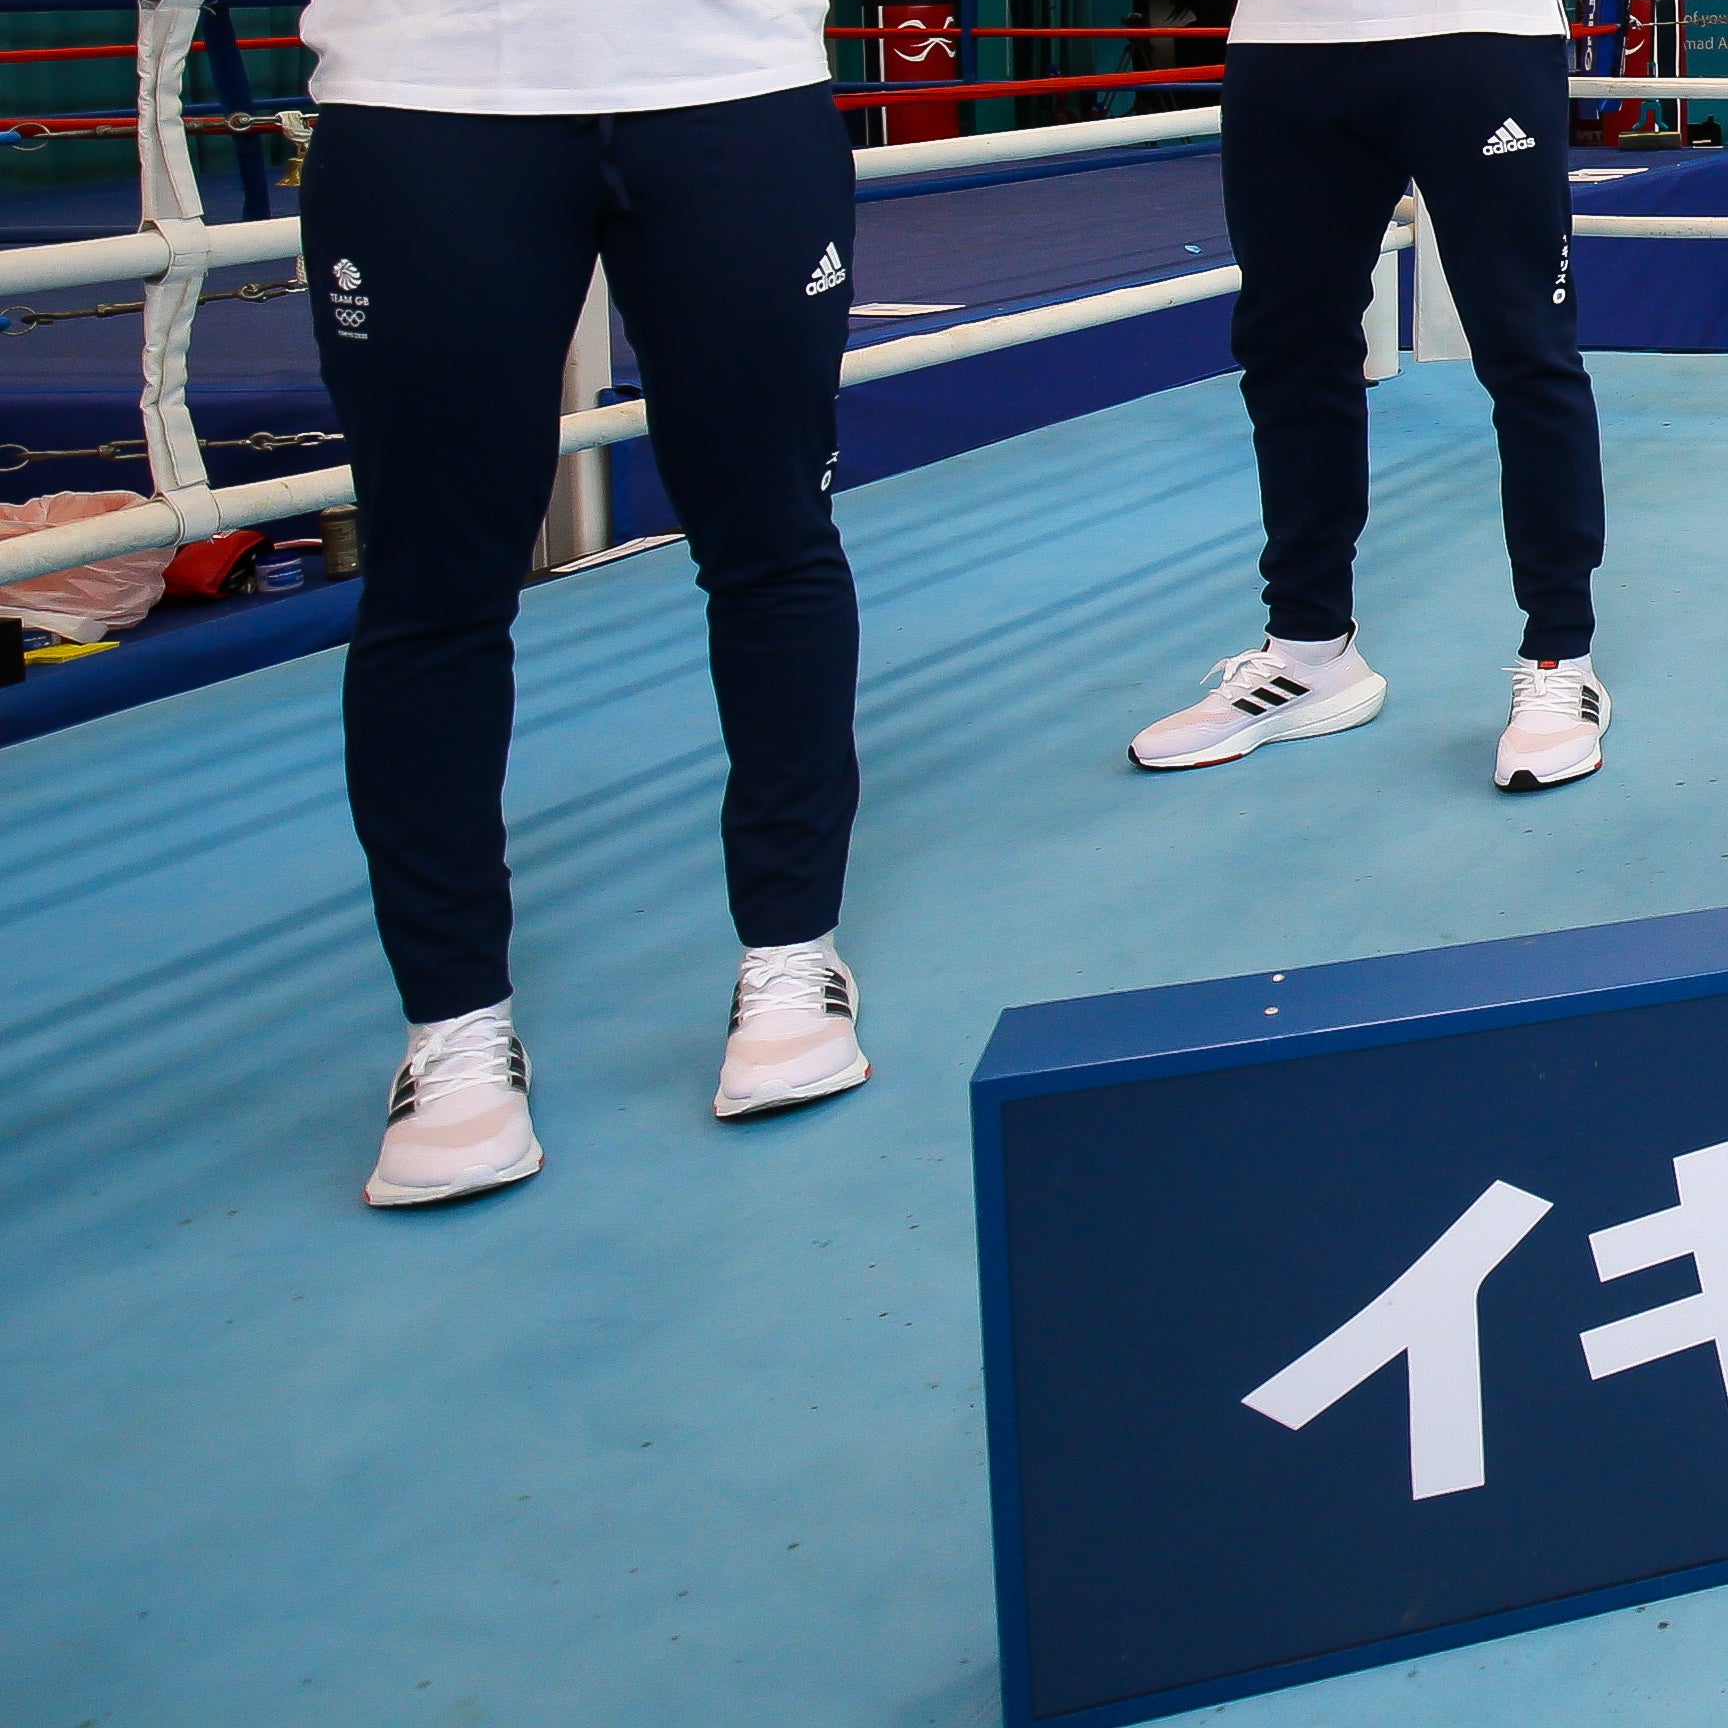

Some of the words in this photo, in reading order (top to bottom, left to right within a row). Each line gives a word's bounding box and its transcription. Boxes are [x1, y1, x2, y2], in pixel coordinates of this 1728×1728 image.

[1684, 11, 1698, 23] of
[1482, 137, 1536, 156] adidas
[329, 291, 353, 305] TEAM
[354, 295, 370, 307] GB
